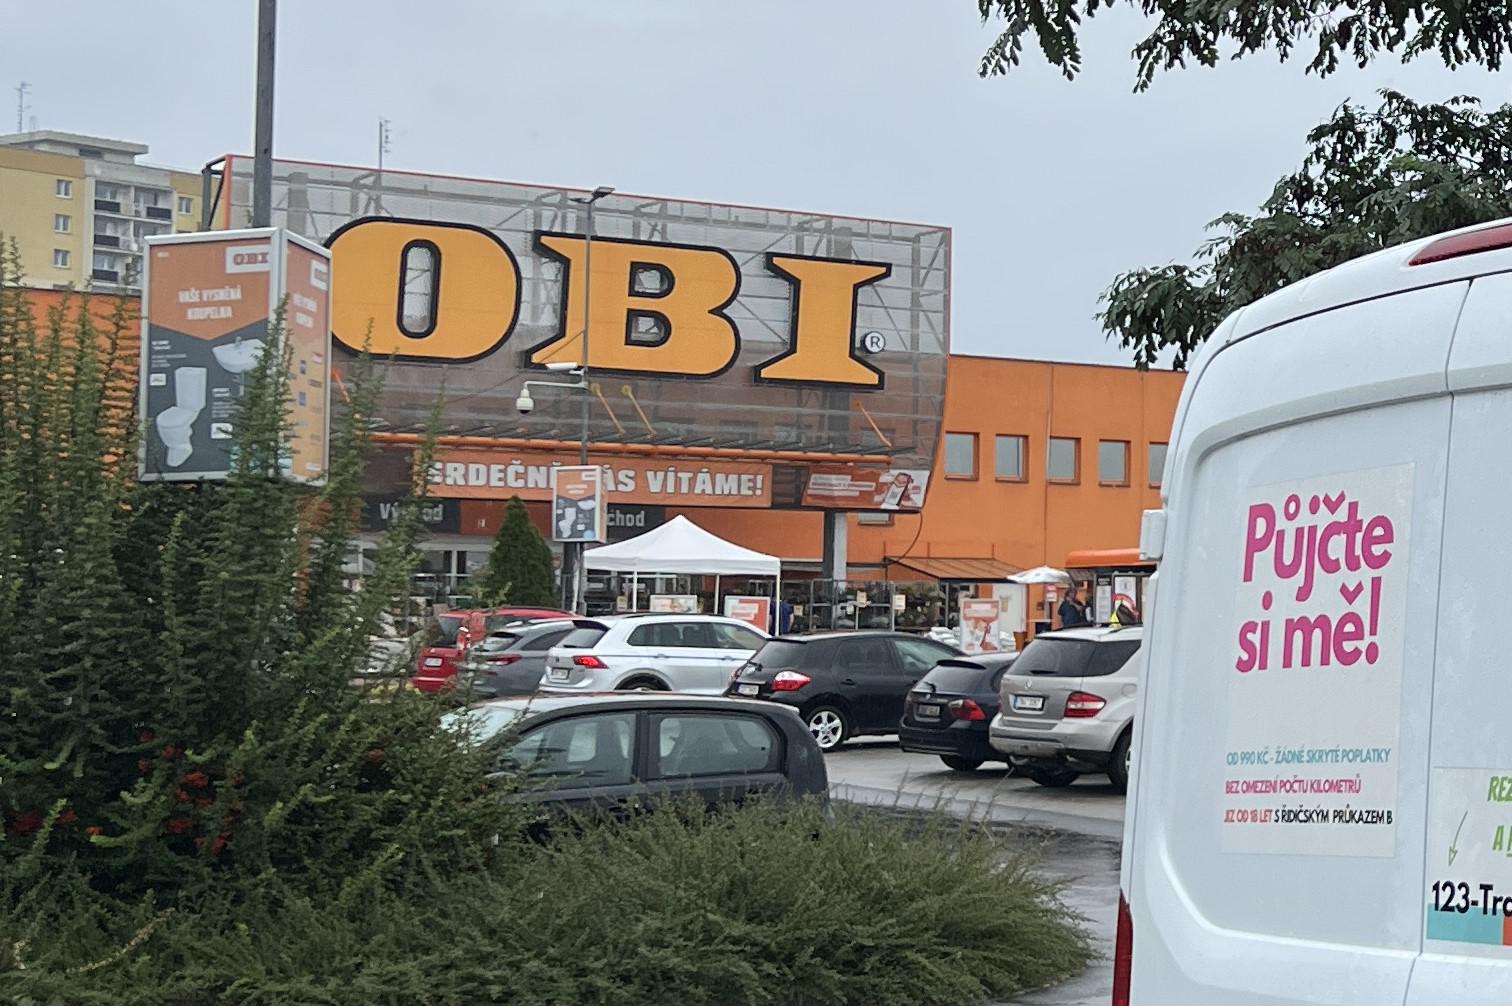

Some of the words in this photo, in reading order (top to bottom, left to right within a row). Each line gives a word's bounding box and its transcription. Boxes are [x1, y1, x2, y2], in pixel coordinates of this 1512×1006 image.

[324, 216, 893, 390] OBI
[646, 465, 764, 496] VÍTÁME!
[1243, 491, 1395, 602] Půjčte
[1235, 590, 1271, 674] si
[1282, 576, 1382, 670] mě!
[1226, 752, 1239, 765] OD
[1240, 751, 1256, 764] 990
[1275, 745, 1305, 764] ŽÁDNÉ
[1306, 744, 1340, 763] SKRYTÉ
[1341, 748, 1391, 763] POPLATKY
[1225, 780, 1240, 794] BEZ
[1241, 775, 1278, 794] OMEZENÍ
[1279, 775, 1309, 793] POČTU
[1309, 774, 1361, 793] KILOMETRŮ
[1259, 809, 1273, 823] LET
[1274, 809, 1280, 823] S
[1281, 804, 1330, 823] ŘIDIČSKÝM
[1332, 804, 1385, 824] PRŮKAZEM
[1386, 811, 1393, 824] B
[1492, 825, 1505, 852] A
